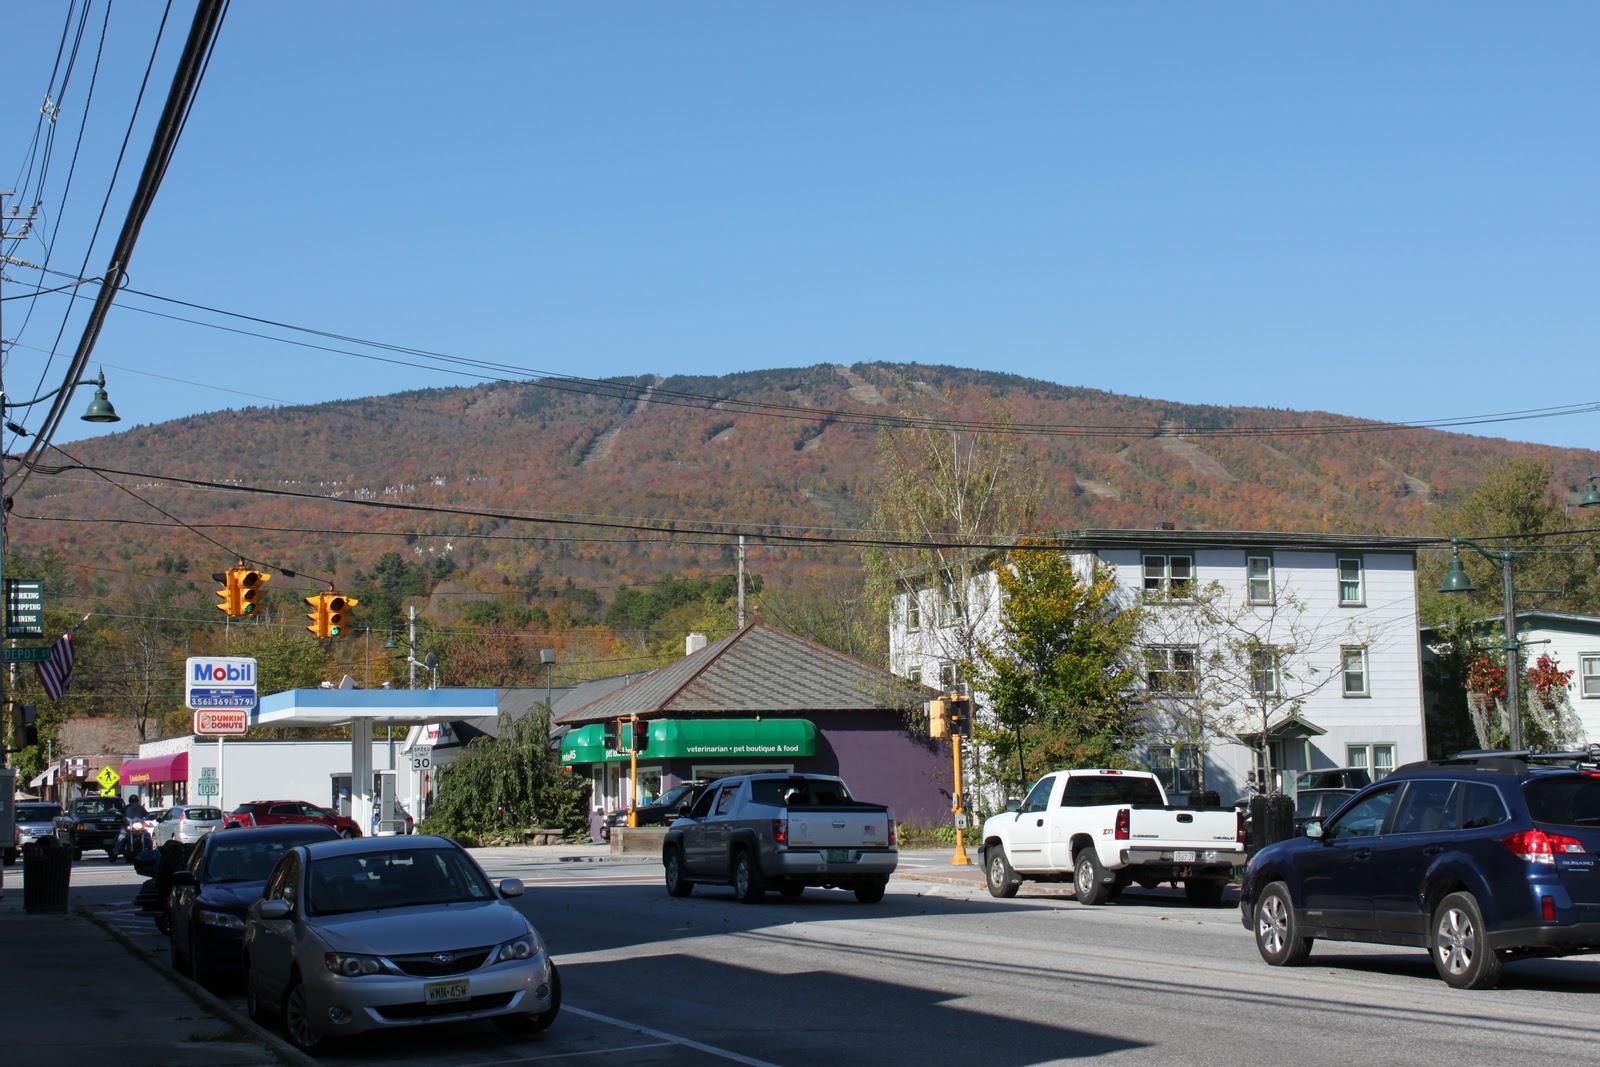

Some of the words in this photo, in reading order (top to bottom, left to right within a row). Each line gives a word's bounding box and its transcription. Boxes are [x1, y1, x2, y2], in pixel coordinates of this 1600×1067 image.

[8, 603, 41, 611] SHOPPING
[4, 648, 37, 660] DEPOT
[194, 663, 251, 681] Mobil
[733, 745, 745, 753] pet
[746, 745, 776, 753] boutique
[413, 758, 430, 768] 30
[203, 769, 215, 777] JCT
